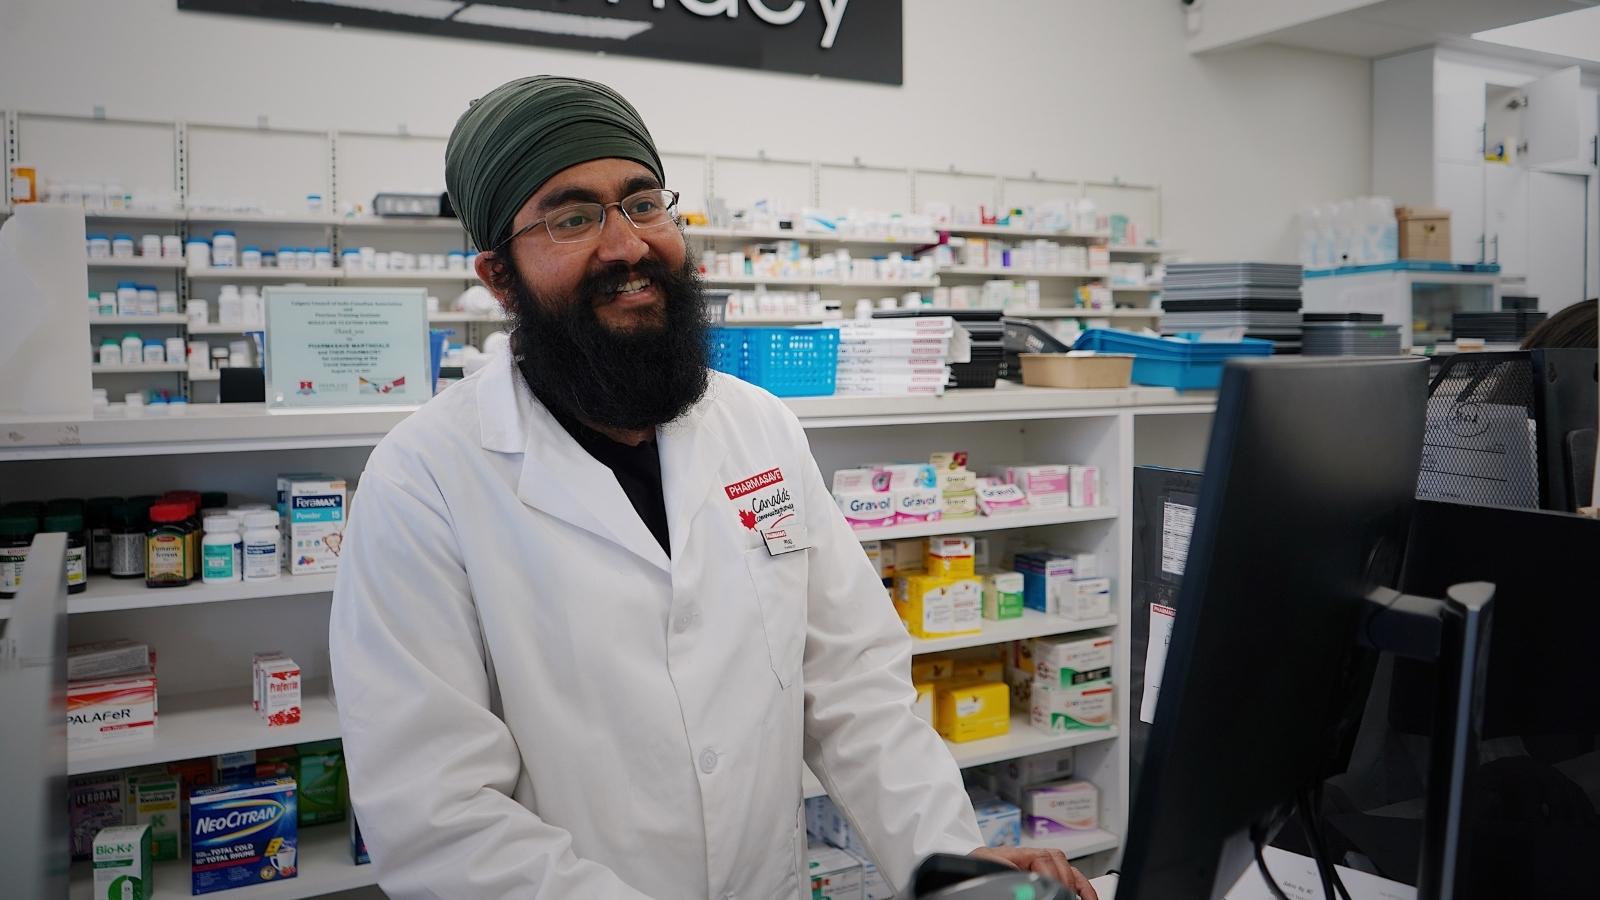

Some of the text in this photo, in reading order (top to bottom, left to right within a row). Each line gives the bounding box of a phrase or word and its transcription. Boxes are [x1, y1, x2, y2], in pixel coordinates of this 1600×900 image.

[728, 470, 781, 496] PHARMASAVE
[850, 496, 936, 511] Gravol Gravol
[331, 510, 340, 519] 15
[210, 847, 234, 856] TOTAL
[234, 843, 254, 852] COLD
[206, 854, 230, 864] TOTAL
